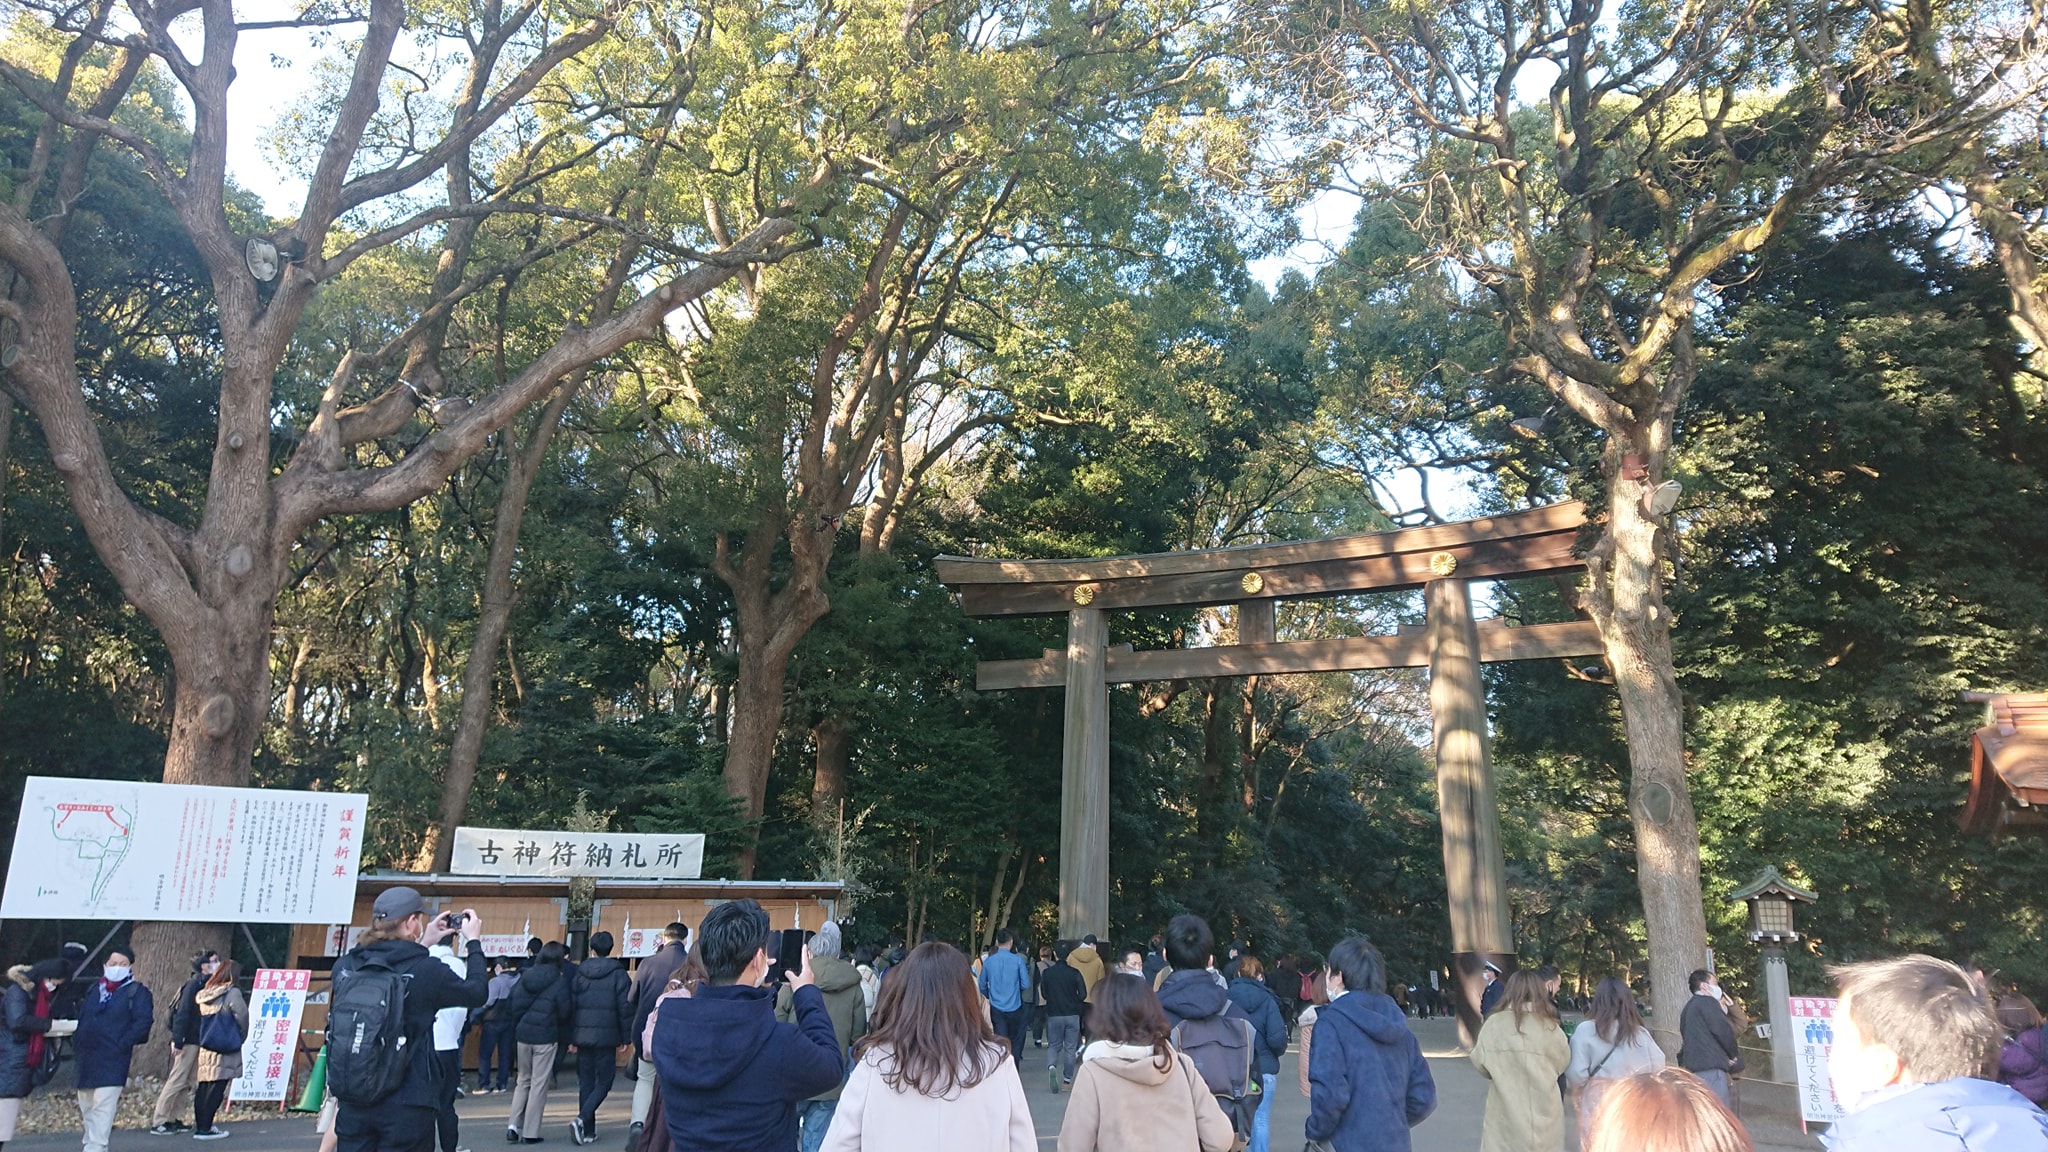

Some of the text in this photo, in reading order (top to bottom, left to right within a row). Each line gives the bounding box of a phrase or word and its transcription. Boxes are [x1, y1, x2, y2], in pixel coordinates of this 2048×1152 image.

[332, 808, 354, 878] 謹賀新年
[477, 837, 683, 870] 古神符納札所
[258, 981, 304, 990] 対策中
[260, 971, 306, 982] 感染予防
[241, 1019, 267, 1089] 避けてください
[265, 1019, 291, 1090] 密集・密接を
[351, 1022, 365, 1054] THULE
[1803, 1045, 1823, 1112] 避けてください
